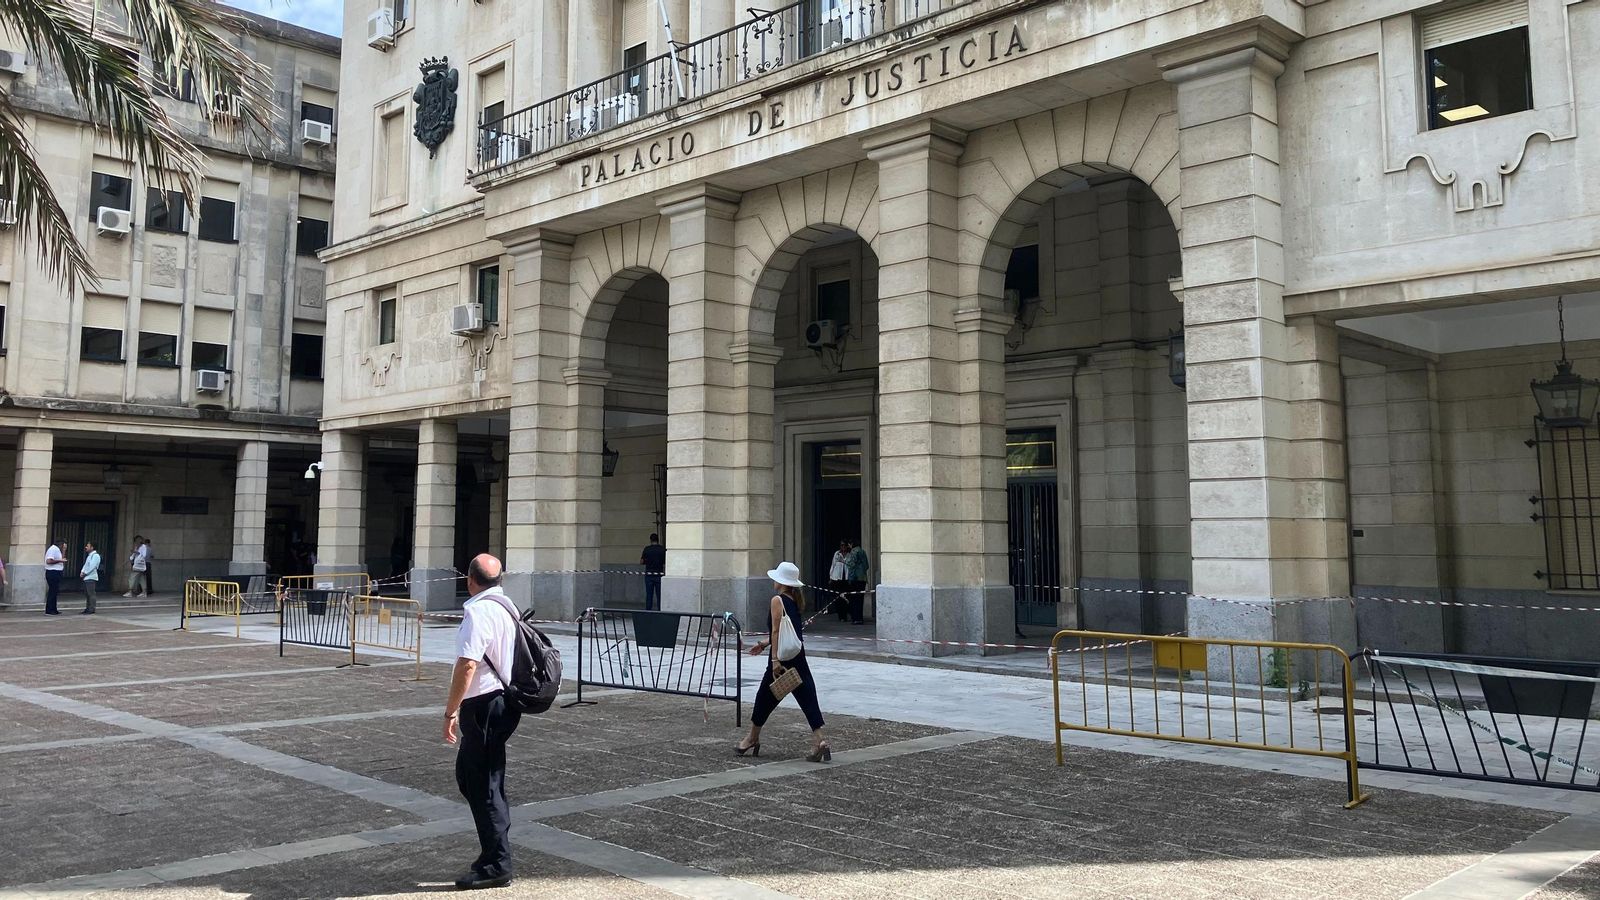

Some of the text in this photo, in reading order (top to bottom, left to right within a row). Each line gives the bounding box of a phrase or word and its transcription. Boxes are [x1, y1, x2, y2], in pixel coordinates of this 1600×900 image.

[580, 24, 1028, 188] PALACIO DE JUSTICIA
